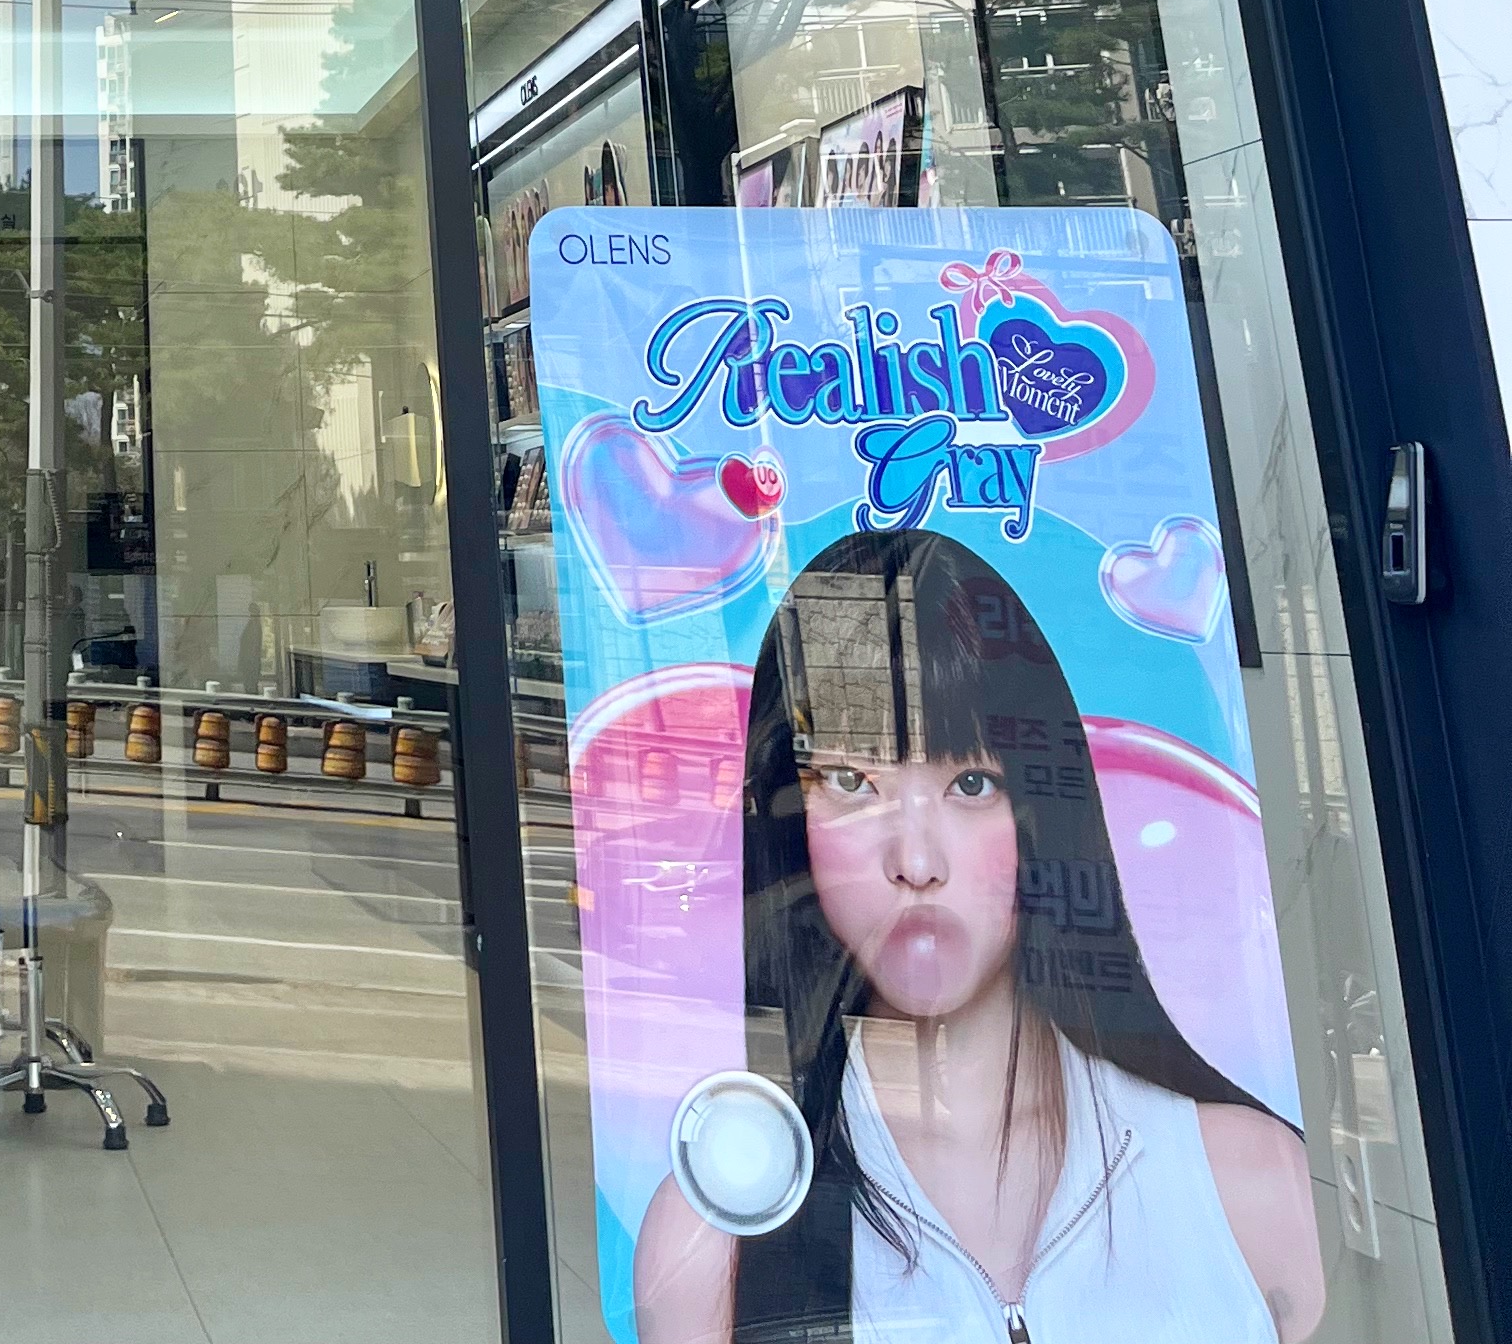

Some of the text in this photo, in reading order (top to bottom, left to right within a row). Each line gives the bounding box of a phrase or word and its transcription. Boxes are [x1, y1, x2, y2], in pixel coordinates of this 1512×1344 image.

[558, 233, 672, 266] OLENS
[633, 296, 1011, 434] Realish
[998, 334, 1094, 404] Lovely
[999, 365, 1080, 426] Moment
[853, 415, 1042, 542] Gray
